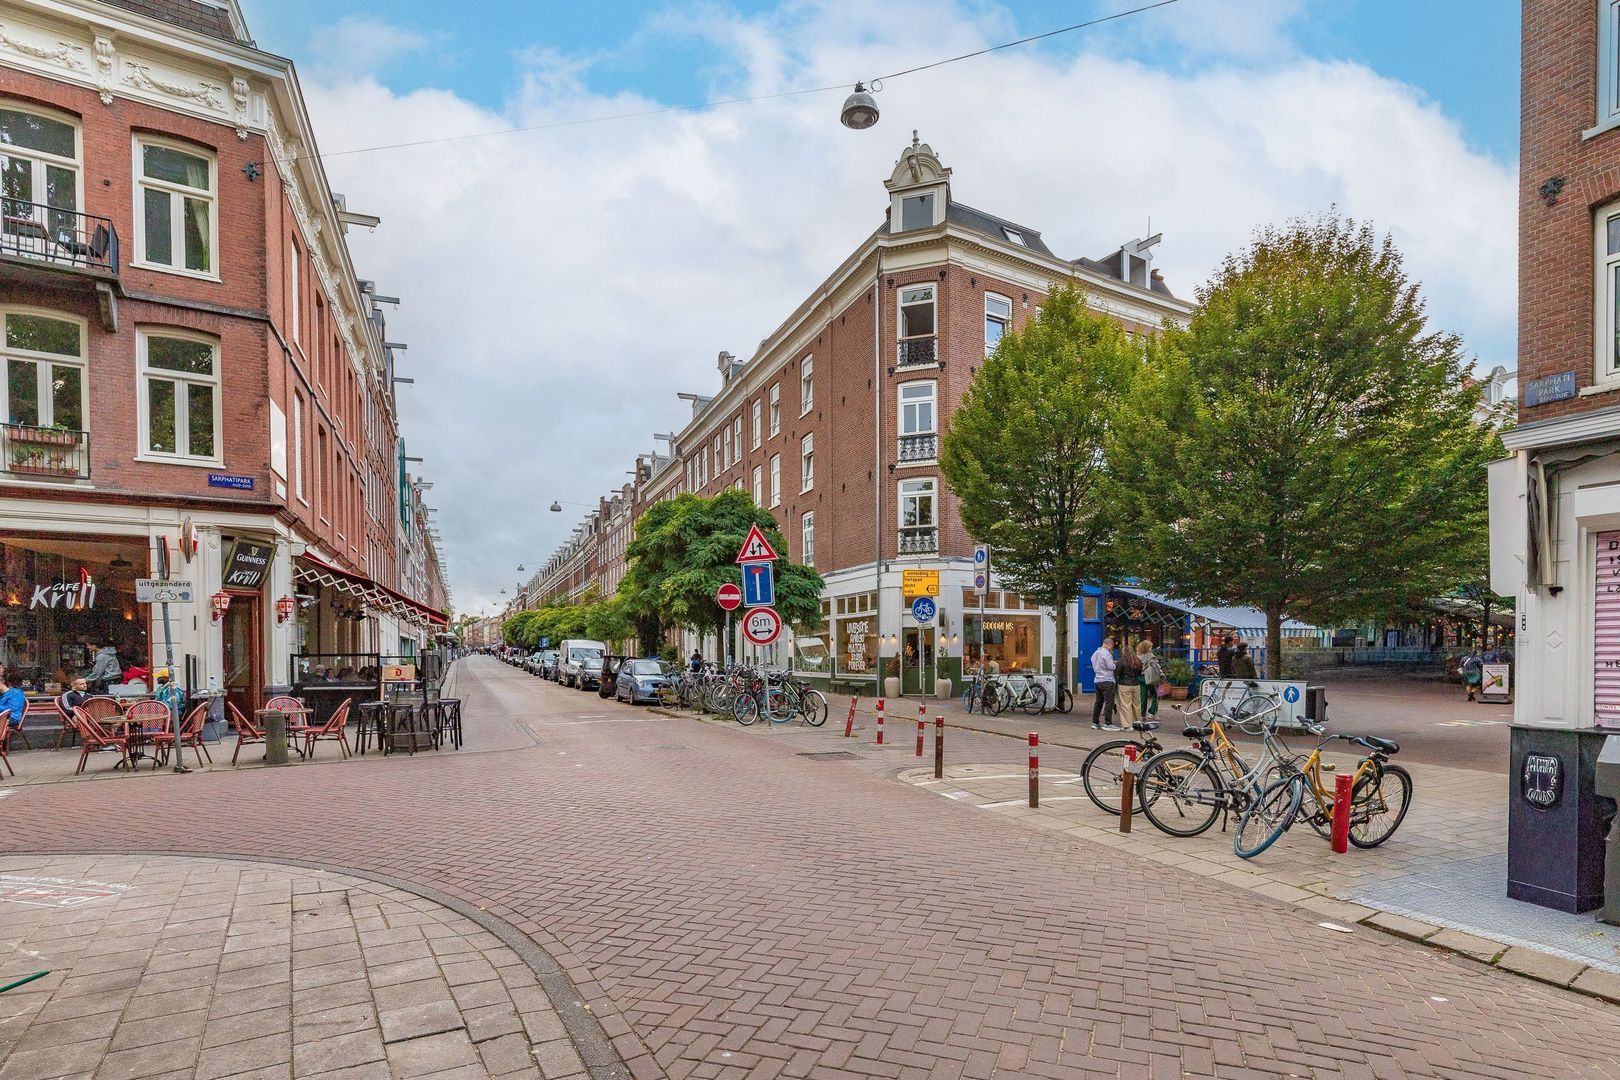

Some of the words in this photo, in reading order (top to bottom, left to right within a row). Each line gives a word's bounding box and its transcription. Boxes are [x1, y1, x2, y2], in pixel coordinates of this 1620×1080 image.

[1530, 374, 1570, 390] SARPHATI
[1538, 385, 1561, 397] PARK
[211, 475, 252, 484] SARPHATIPARK
[236, 553, 266, 565] GUINNESS
[227, 570, 261, 585] Krull
[52, 582, 80, 592] CAFE
[30, 582, 96, 610] Krull
[751, 616, 771, 627] 6m
